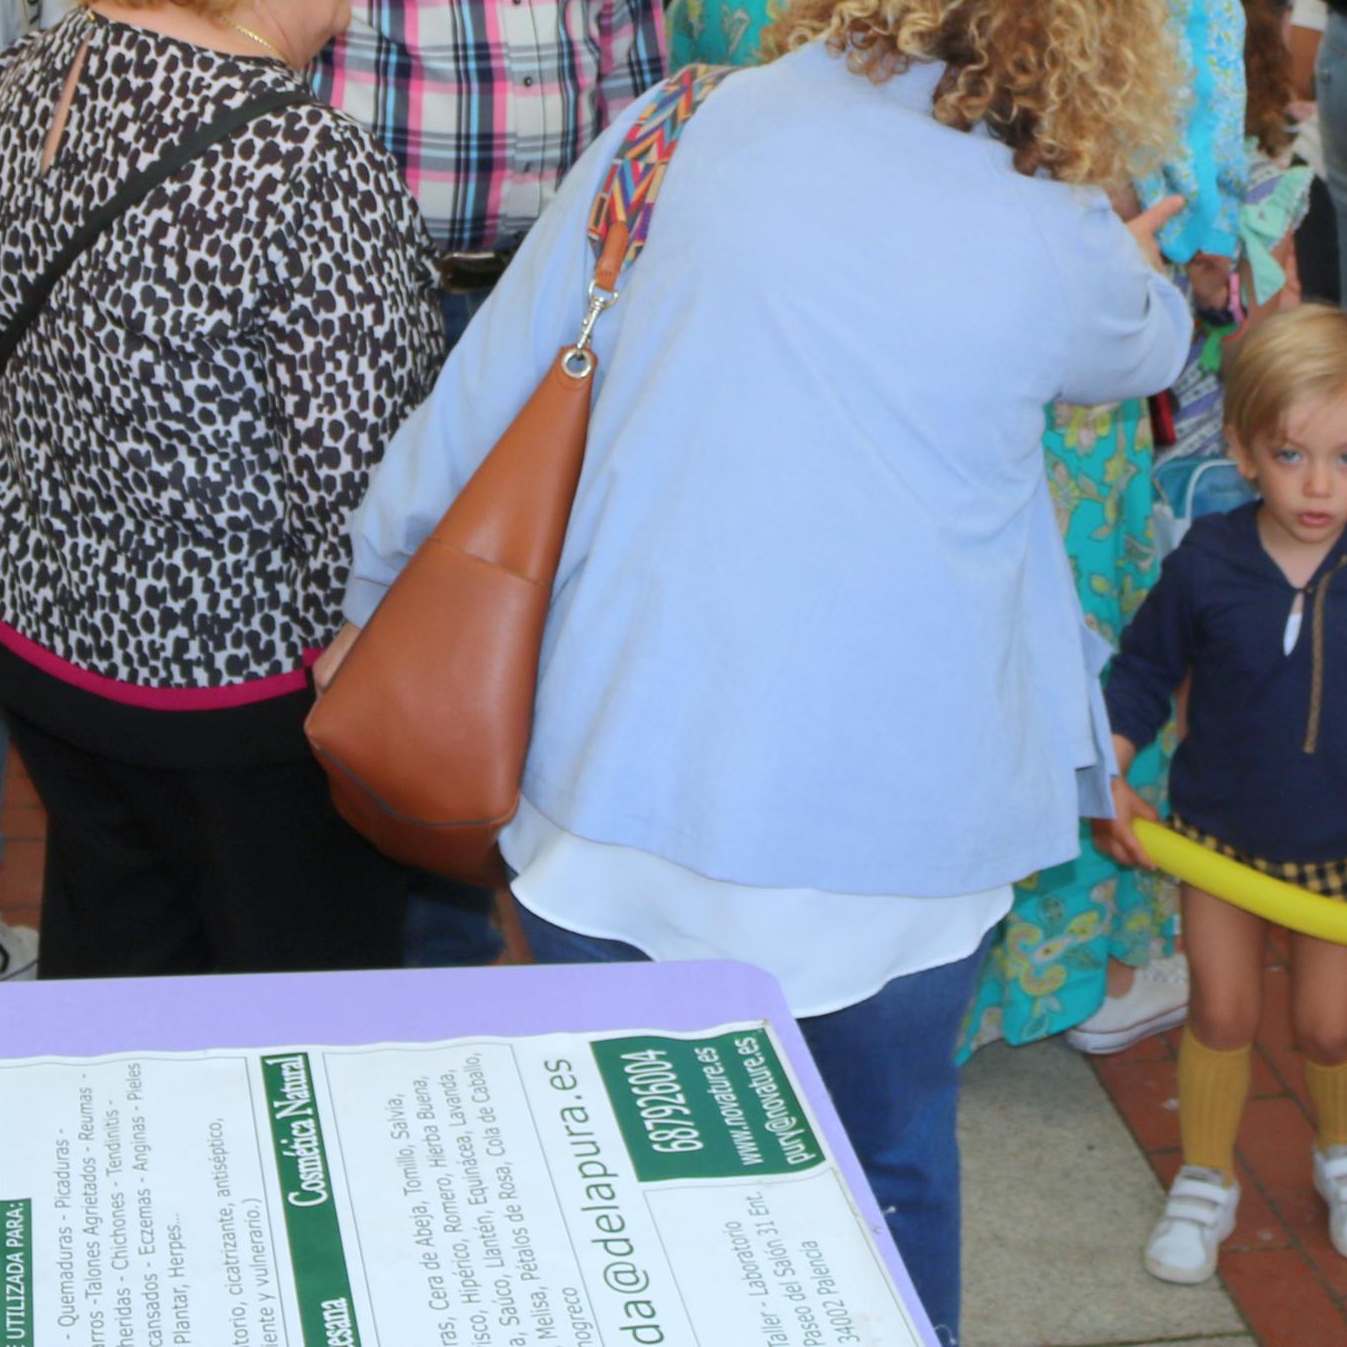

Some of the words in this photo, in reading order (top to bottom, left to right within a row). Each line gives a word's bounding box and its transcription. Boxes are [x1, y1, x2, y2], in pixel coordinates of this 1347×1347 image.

[126, 1062, 142, 1100] Pieles
[264, 1054, 313, 1119] Natural
[410, 1075, 435, 1119] Buena,
[437, 1069, 468, 1126] Lavanda,
[461, 1052, 486, 1102] Caballo,
[620, 1048, 704, 1152] 687926004
[733, 1037, 816, 1165] pury@novature.es
[77, 1087, 94, 1141] Reumas
[384, 1093, 412, 1139] Salvia,
[473, 1106, 497, 1123] de
[693, 1047, 765, 1165] www.novature.es
[103, 1109, 123, 1176] Tendinitis
[130, 1116, 152, 1171] Anginas
[207, 1117, 231, 1197] antiséptico,
[281, 1118, 329, 1207] Cosmética
[418, 1125, 448, 1167] Hierba
[457, 1131, 487, 1205] Equinácea,
[482, 1126, 507, 1156] Cola
[54, 1139, 71, 1208] Picaduras
[79, 1157, 102, 1235] Agrietados
[396, 1145, 423, 1196] Tomillo,
[492, 1162, 518, 1199] Rosa,
[6, 1202, 24, 1247] PARA:
[136, 1188, 156, 1255] Eczemas
[409, 1200, 433, 1247] Abeja,
[434, 1173, 463, 1233] Romero,
[503, 1204, 524, 1222] de
[745, 1191, 772, 1216] Ent.
[763, 1220, 783, 1235] 31
[110, 1192, 130, 1270] Chichones
[165, 1213, 189, 1277] Herpes...
[217, 1202, 243, 1295] cicatrizante,
[241, 1197, 269, 1286] vulnerario.)
[474, 1210, 505, 1267] Llantén,
[510, 1227, 541, 1281] Pétalos
[723, 1220, 762, 1296] Laboratorio
[769, 1238, 798, 1276] Salón
[56, 1226, 79, 1327] Quemaduras
[416, 1252, 441, 1270] de
[451, 1239, 481, 1303] Hipérico,
[799, 1240, 837, 1295] Palencia
[6, 1252, 25, 1339] UTILIZADA
[115, 1287, 134, 1346] heridas
[142, 1273, 163, 1347] cansados
[171, 1284, 191, 1344] Plantar,
[257, 1292, 275, 1301] y
[426, 1276, 450, 1310] Cera
[492, 1274, 520, 1326] Saúco,
[527, 1286, 559, 1339] Melisa,
[782, 1281, 807, 1301] del
[230, 1301, 250, 1347] torio,
[319, 1297, 356, 1347] esana
[761, 1311, 791, 1347] Taller
[798, 1306, 827, 1346] Paseo
[830, 1299, 860, 1343] 34002
